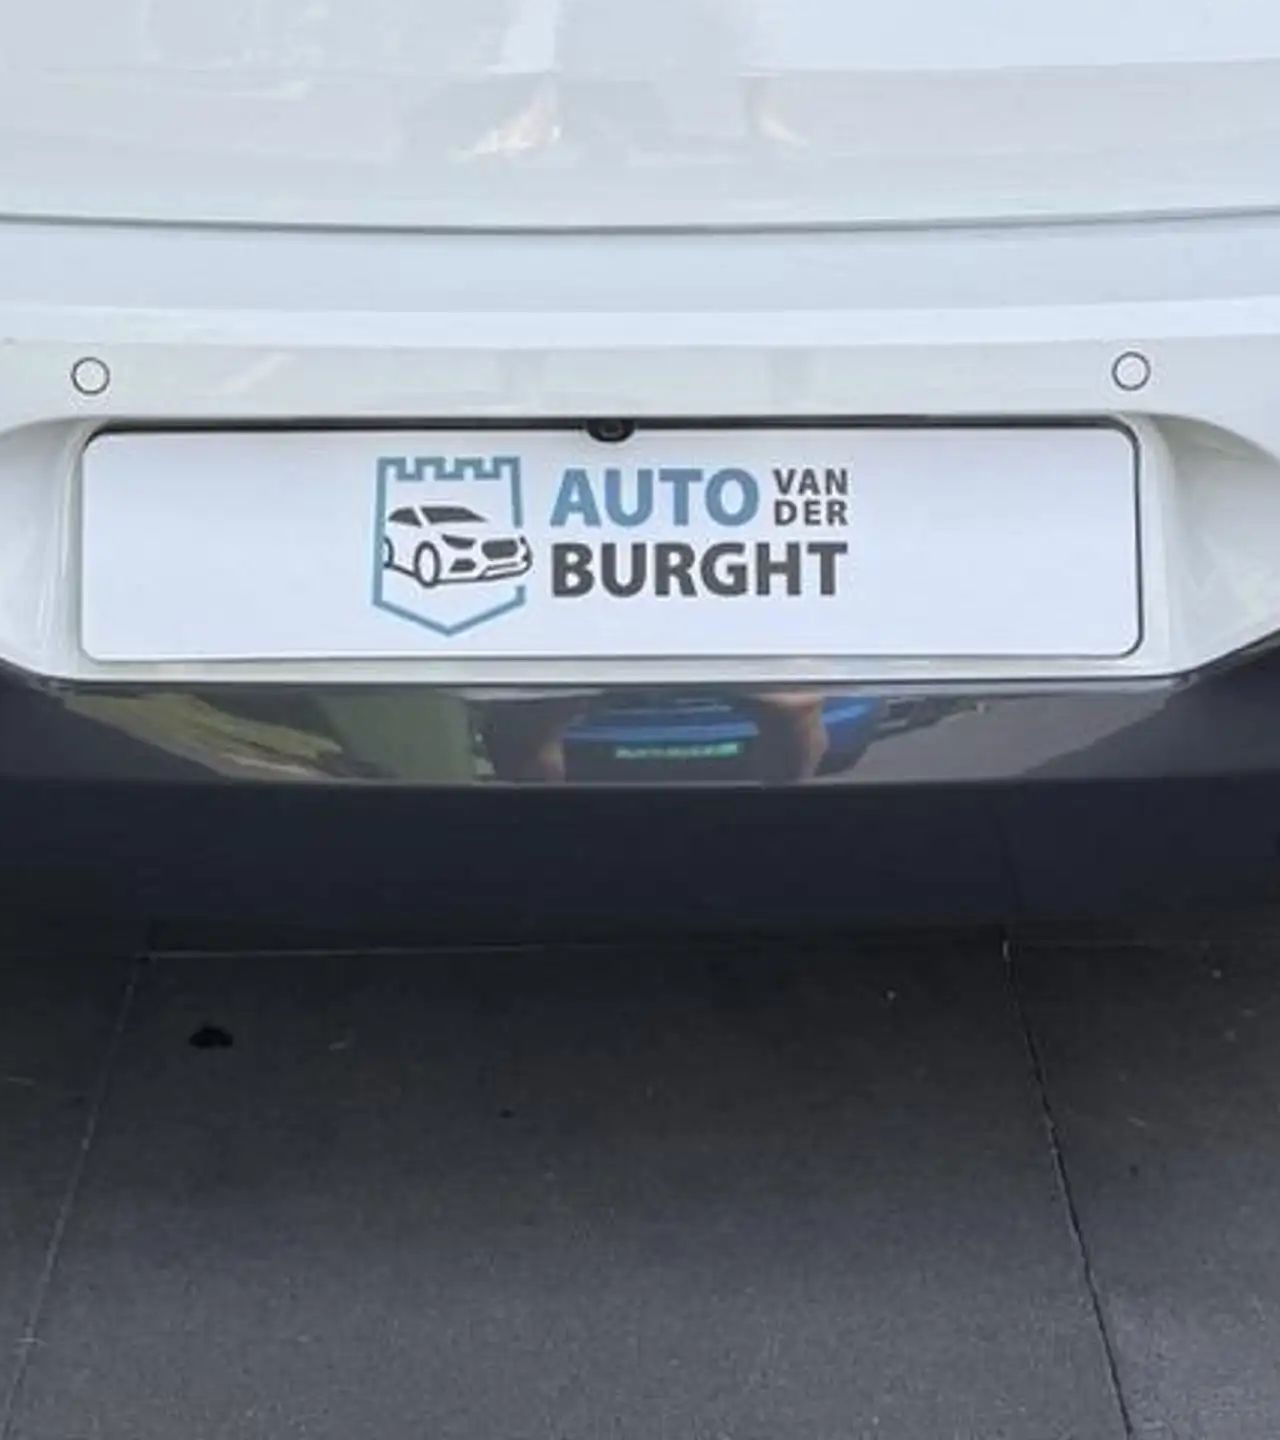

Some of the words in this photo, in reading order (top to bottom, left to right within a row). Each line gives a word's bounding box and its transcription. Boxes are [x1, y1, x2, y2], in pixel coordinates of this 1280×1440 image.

[549, 468, 760, 527] AUTO
[773, 468, 848, 496] VAN
[773, 500, 848, 527] DER
[551, 542, 848, 597] BURGHT
